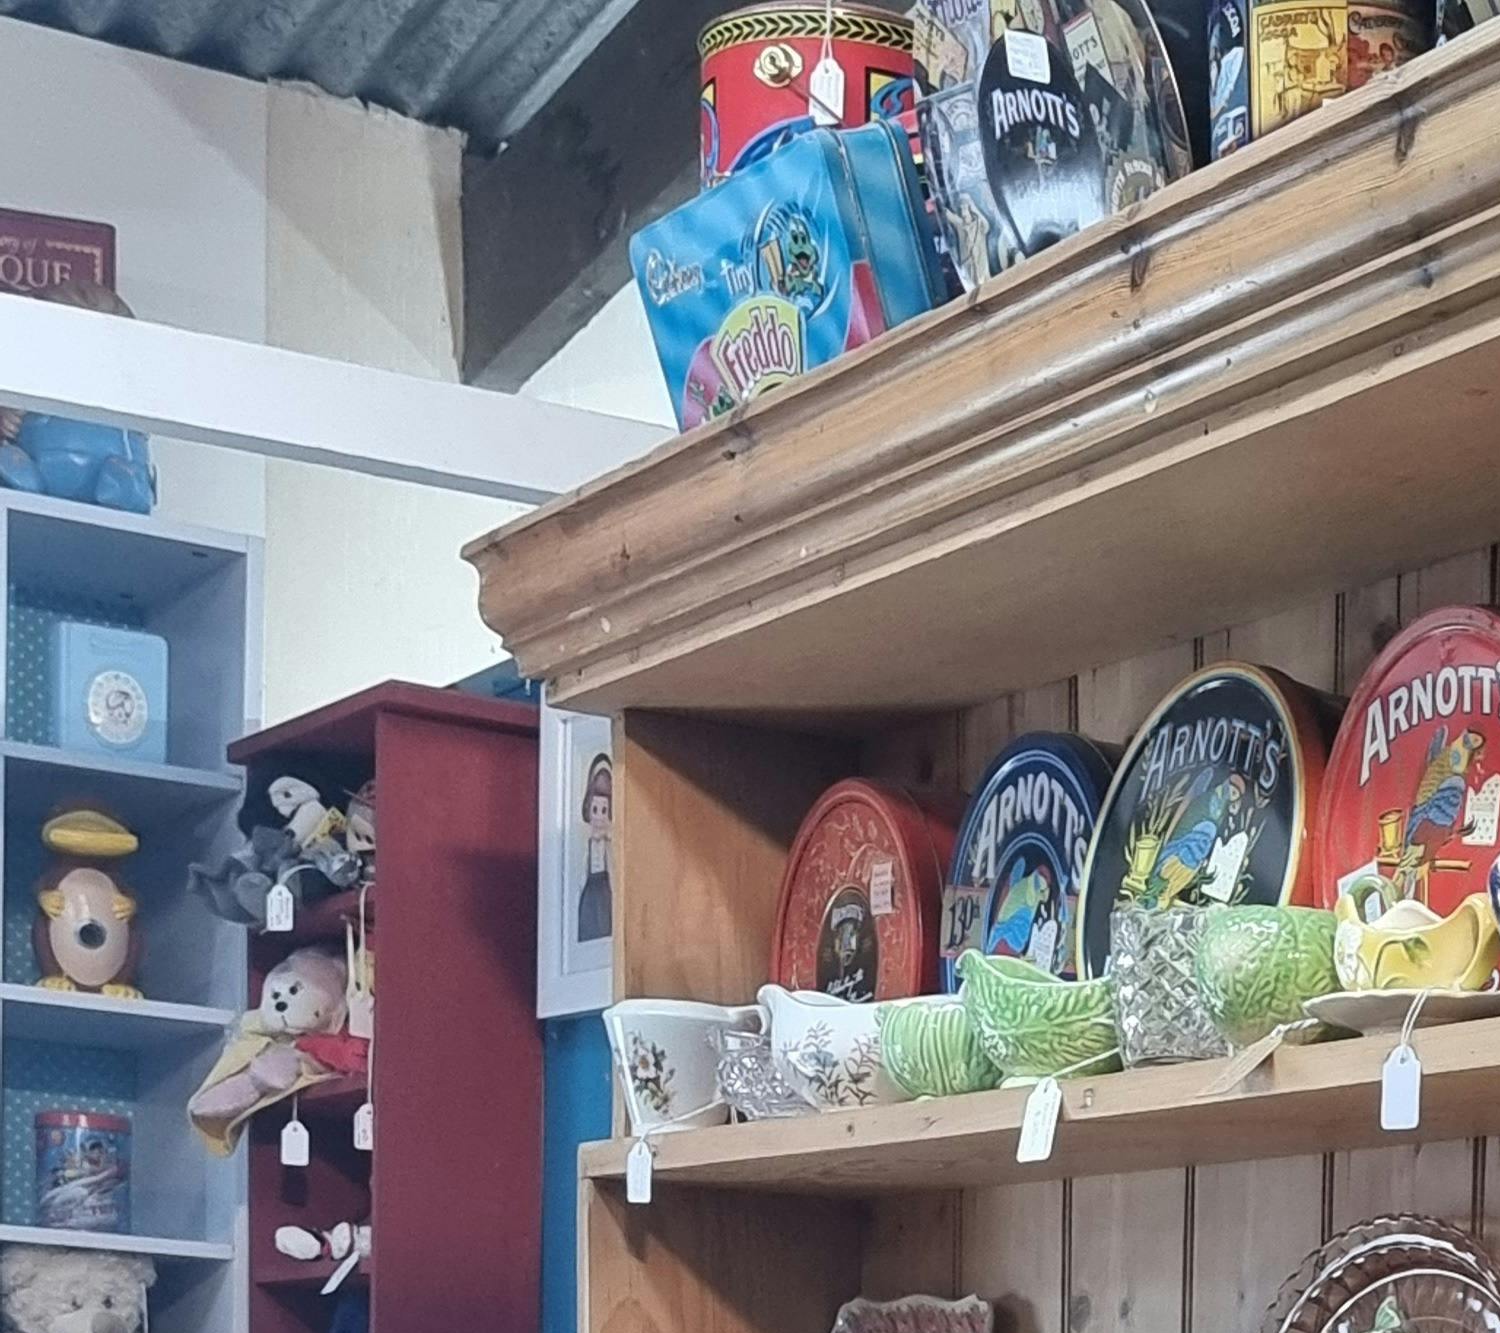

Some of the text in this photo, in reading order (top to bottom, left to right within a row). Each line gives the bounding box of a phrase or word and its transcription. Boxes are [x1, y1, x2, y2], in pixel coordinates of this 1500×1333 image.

[991, 87, 1080, 140] ARNOTT'S
[720, 302, 801, 389] Freddo
[1139, 716, 1283, 801] ARNOTT'S
[971, 773, 1088, 894] ARNOTT'S
